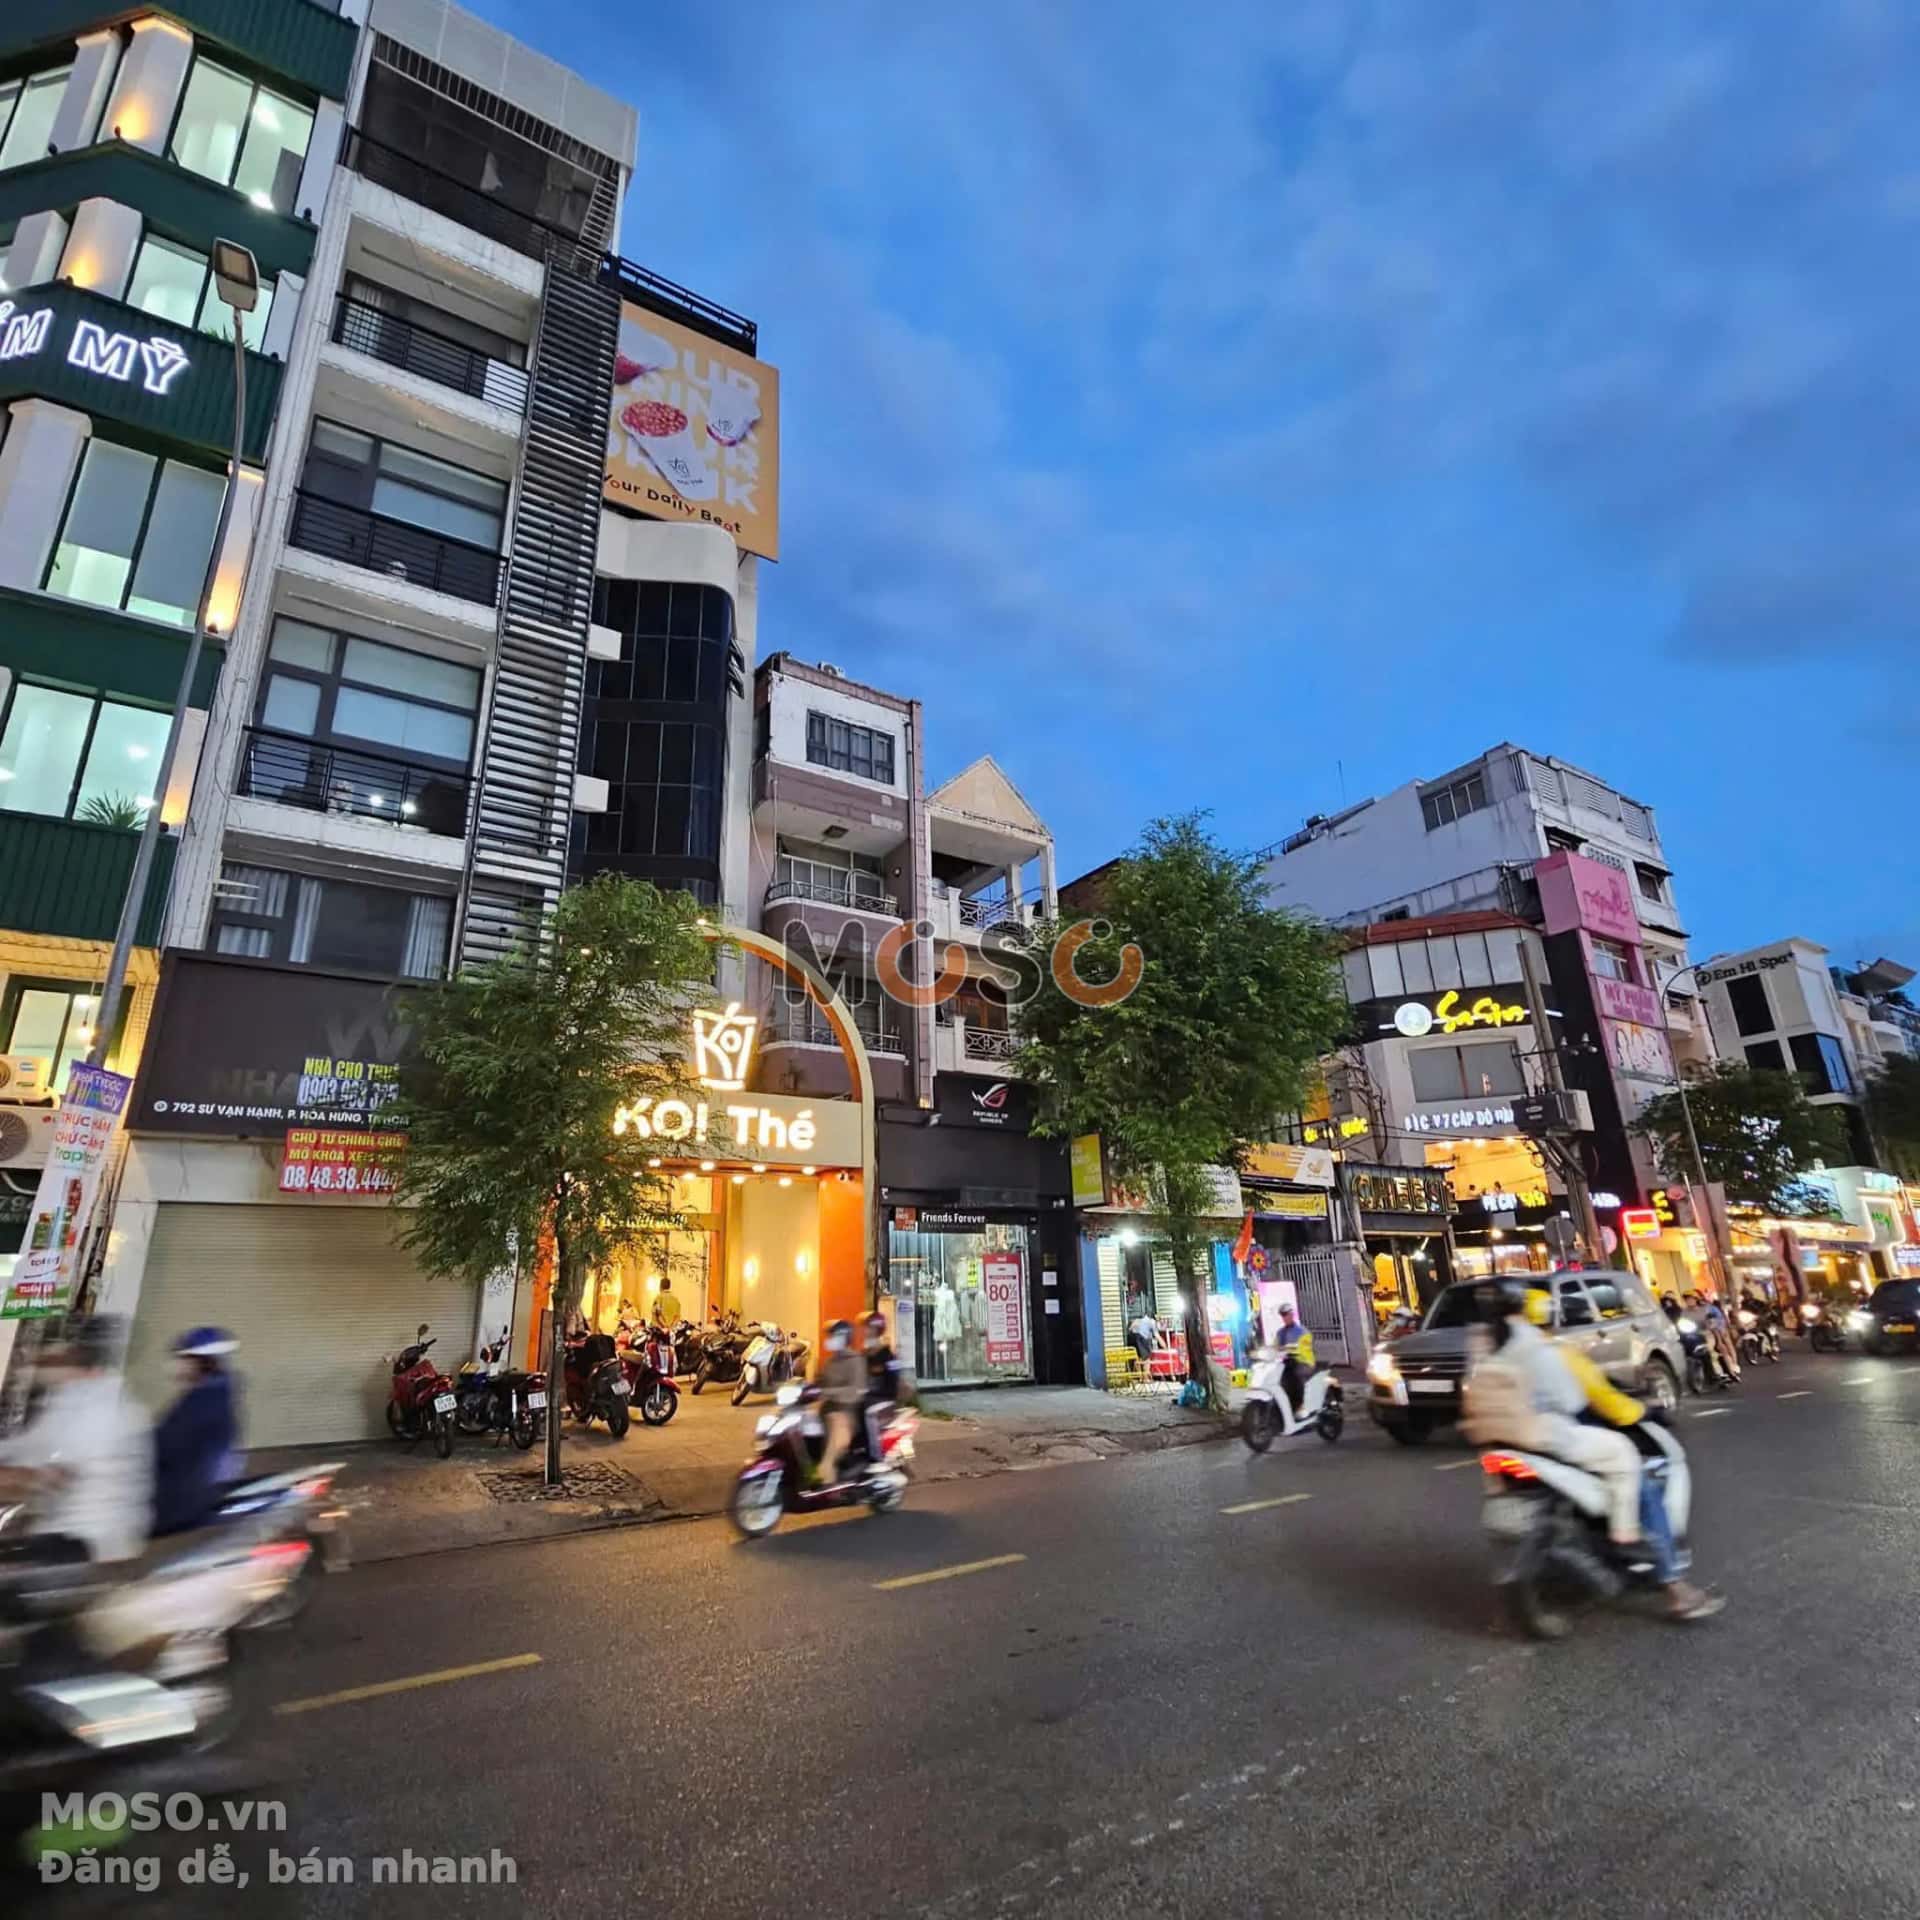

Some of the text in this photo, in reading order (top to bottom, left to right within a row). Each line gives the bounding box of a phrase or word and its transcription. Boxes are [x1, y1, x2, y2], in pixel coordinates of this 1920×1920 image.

[67, 319, 191, 395] MỸ
[603, 474, 742, 533] Your Daily Beat
[303, 1056, 399, 1081] NHÀ CHO THU
[171, 1103, 195, 1114] 792
[217, 1105, 242, 1119] VẠN
[245, 1107, 284, 1120] HẠNH,
[286, 1109, 298, 1120] P.
[727, 1104, 816, 1150] Thé
[350, 1151, 374, 1162] XE
[921, 1211, 953, 1224] Friends
[953, 1212, 986, 1224] Forever
